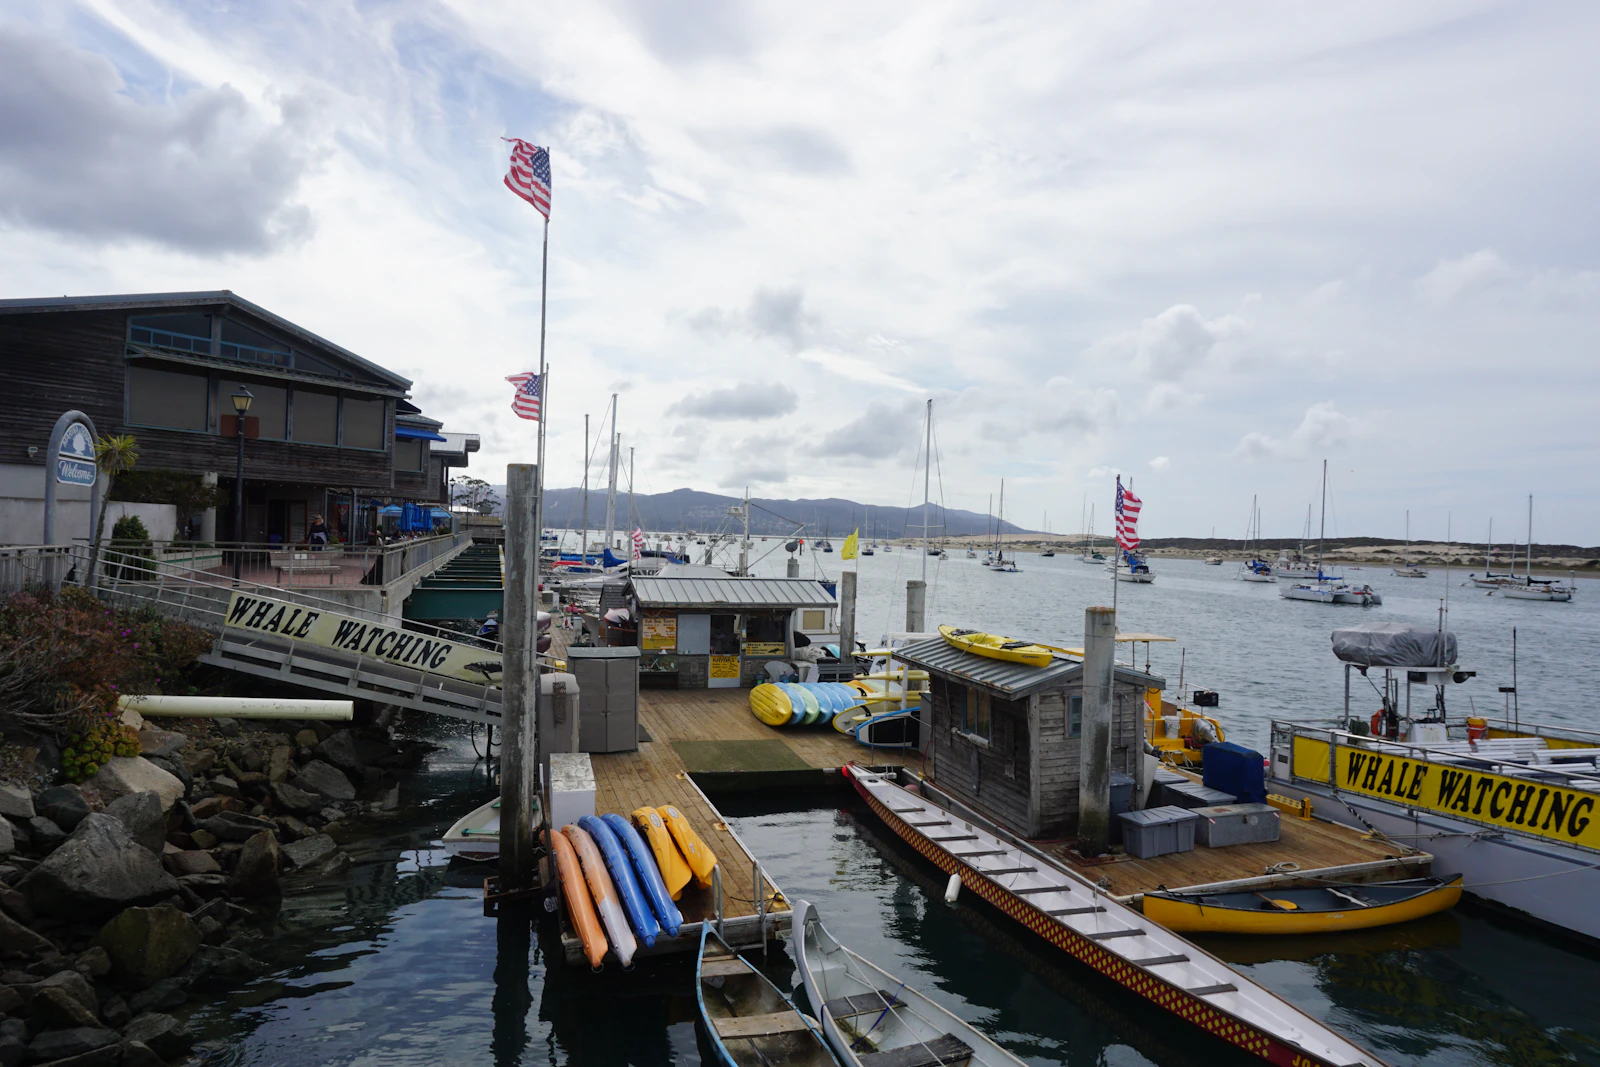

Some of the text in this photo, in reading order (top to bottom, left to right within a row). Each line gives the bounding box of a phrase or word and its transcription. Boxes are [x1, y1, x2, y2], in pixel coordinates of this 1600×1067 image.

[58, 460, 94, 480] Welcome
[227, 596, 453, 669] WHALE WATCHING
[1347, 752, 1595, 837] WHALE WATCHING
[1291, 1054, 1321, 1067] JO
